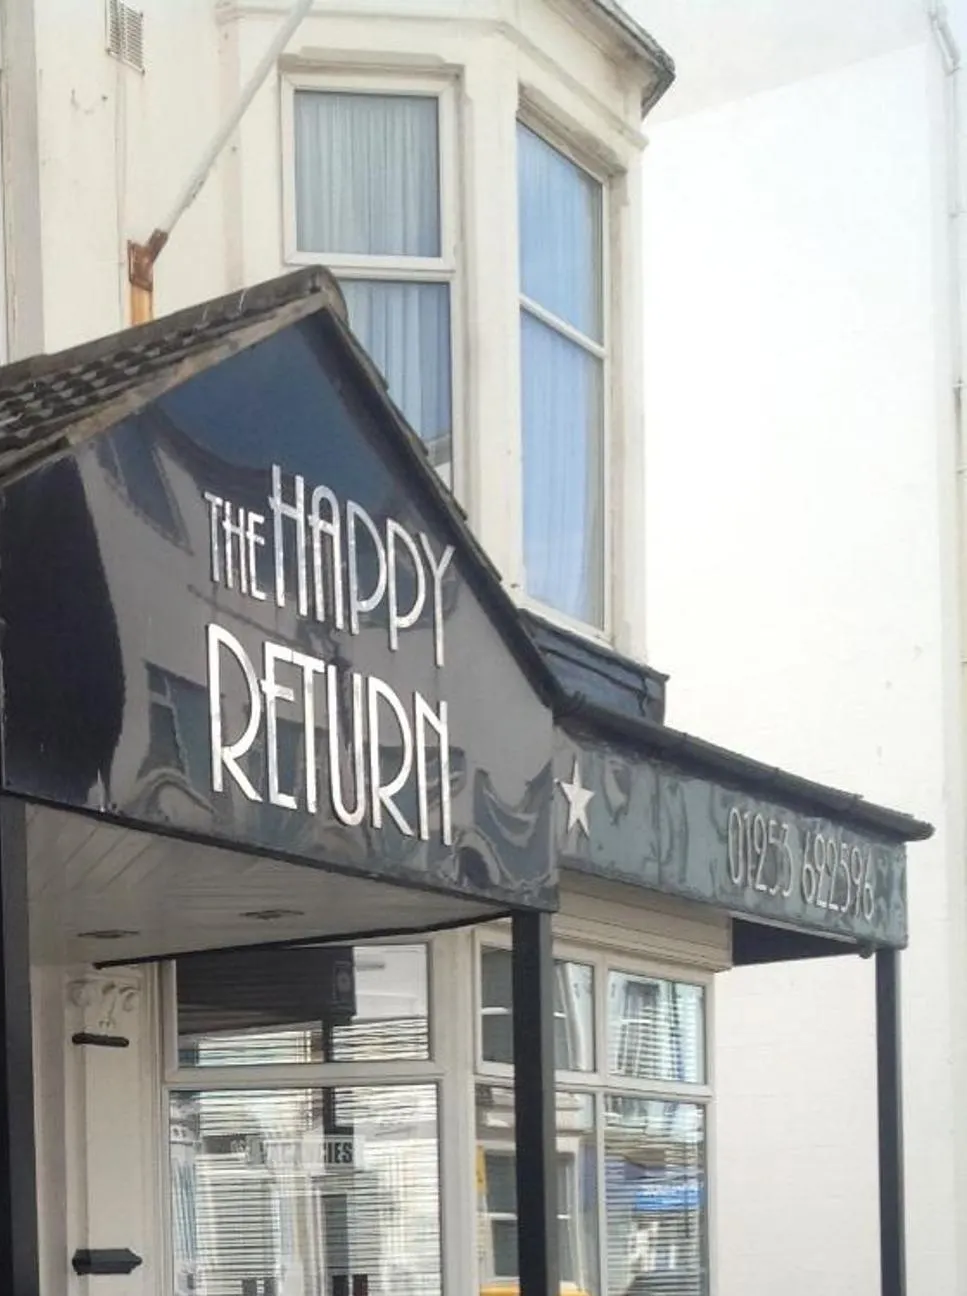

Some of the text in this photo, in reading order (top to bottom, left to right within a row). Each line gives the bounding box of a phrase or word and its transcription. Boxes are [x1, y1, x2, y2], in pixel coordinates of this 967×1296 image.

[203, 463, 456, 668] THE HAPPY
[206, 622, 452, 846] RETURN
[728, 806, 793, 897] 01253
